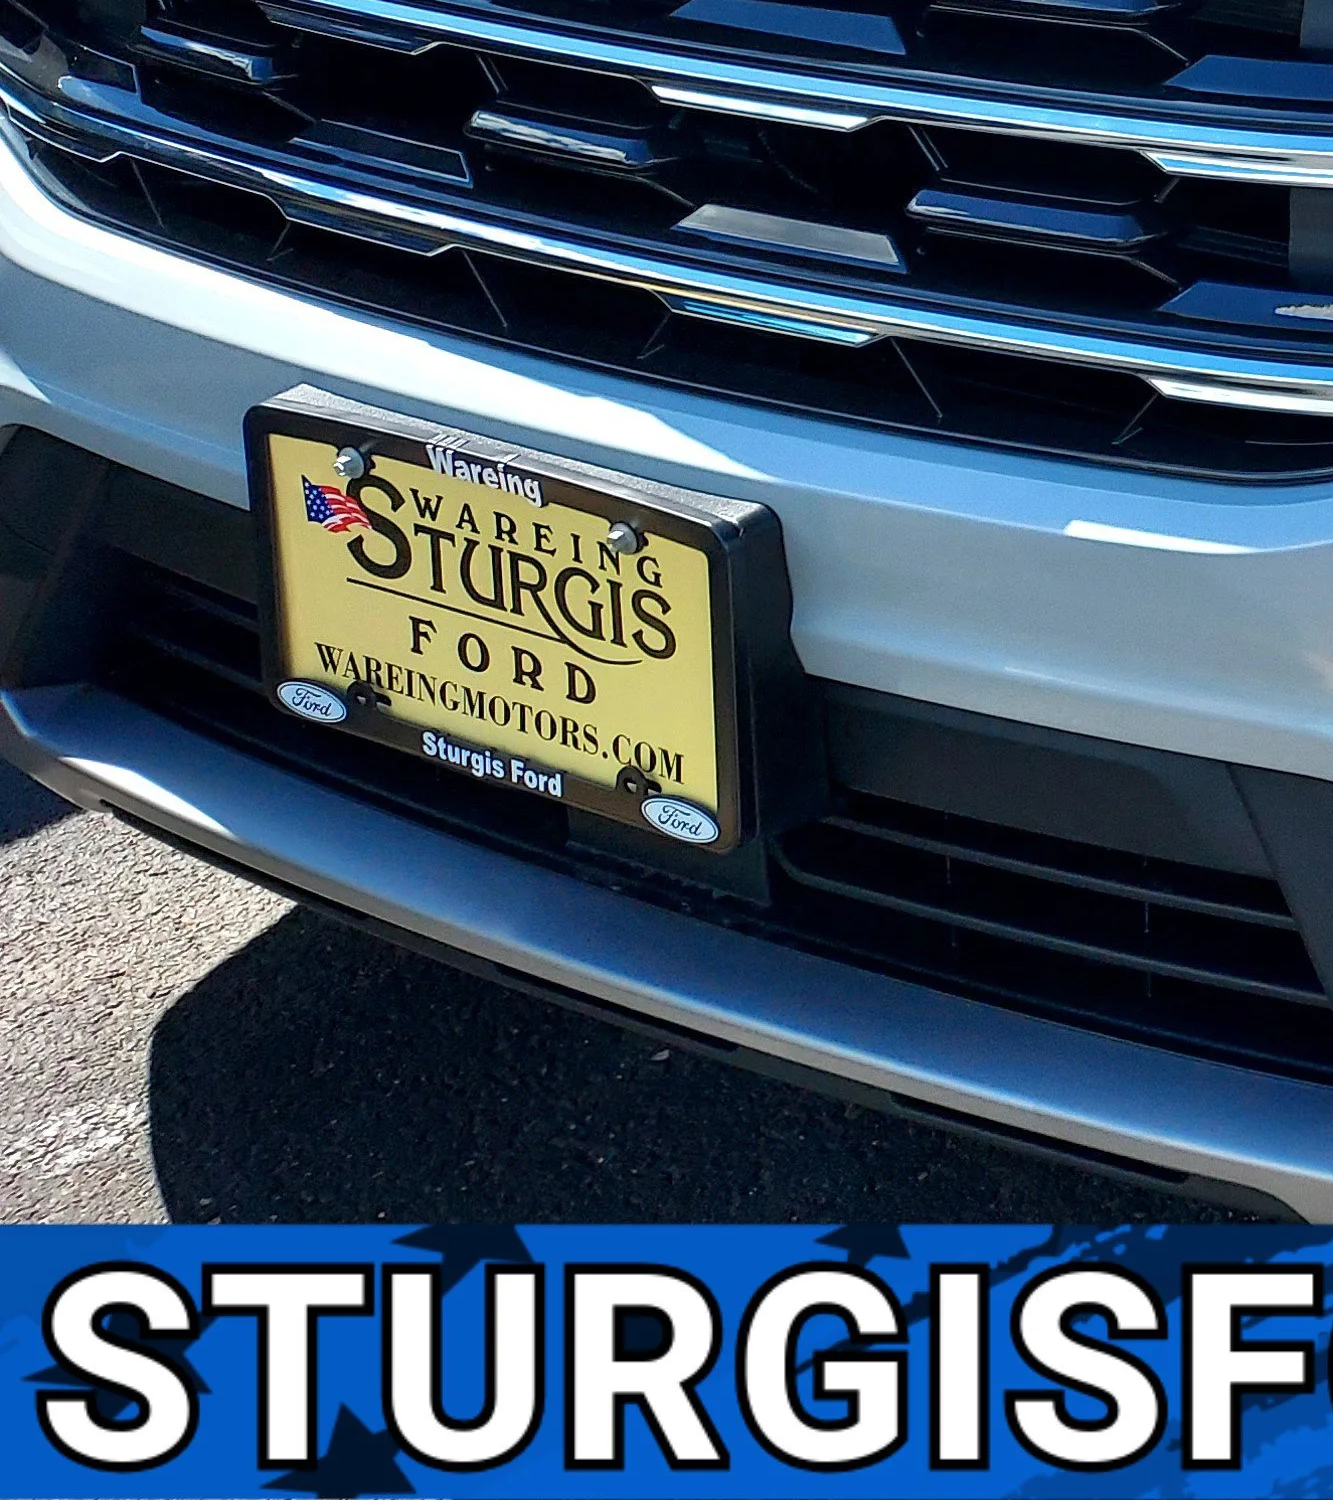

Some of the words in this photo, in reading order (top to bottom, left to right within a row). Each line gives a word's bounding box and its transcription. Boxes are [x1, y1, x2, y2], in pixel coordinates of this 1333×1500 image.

[426, 444, 543, 507] Wareing
[345, 475, 677, 665] STURGIS
[409, 488, 663, 587] WAREING
[408, 616, 597, 704] FORD
[291, 688, 333, 718] Ford
[314, 641, 685, 784] WAREINGMOTORS.COM
[422, 731, 505, 779] Sturgis
[510, 759, 564, 798] Ford
[657, 805, 702, 837] Ford
